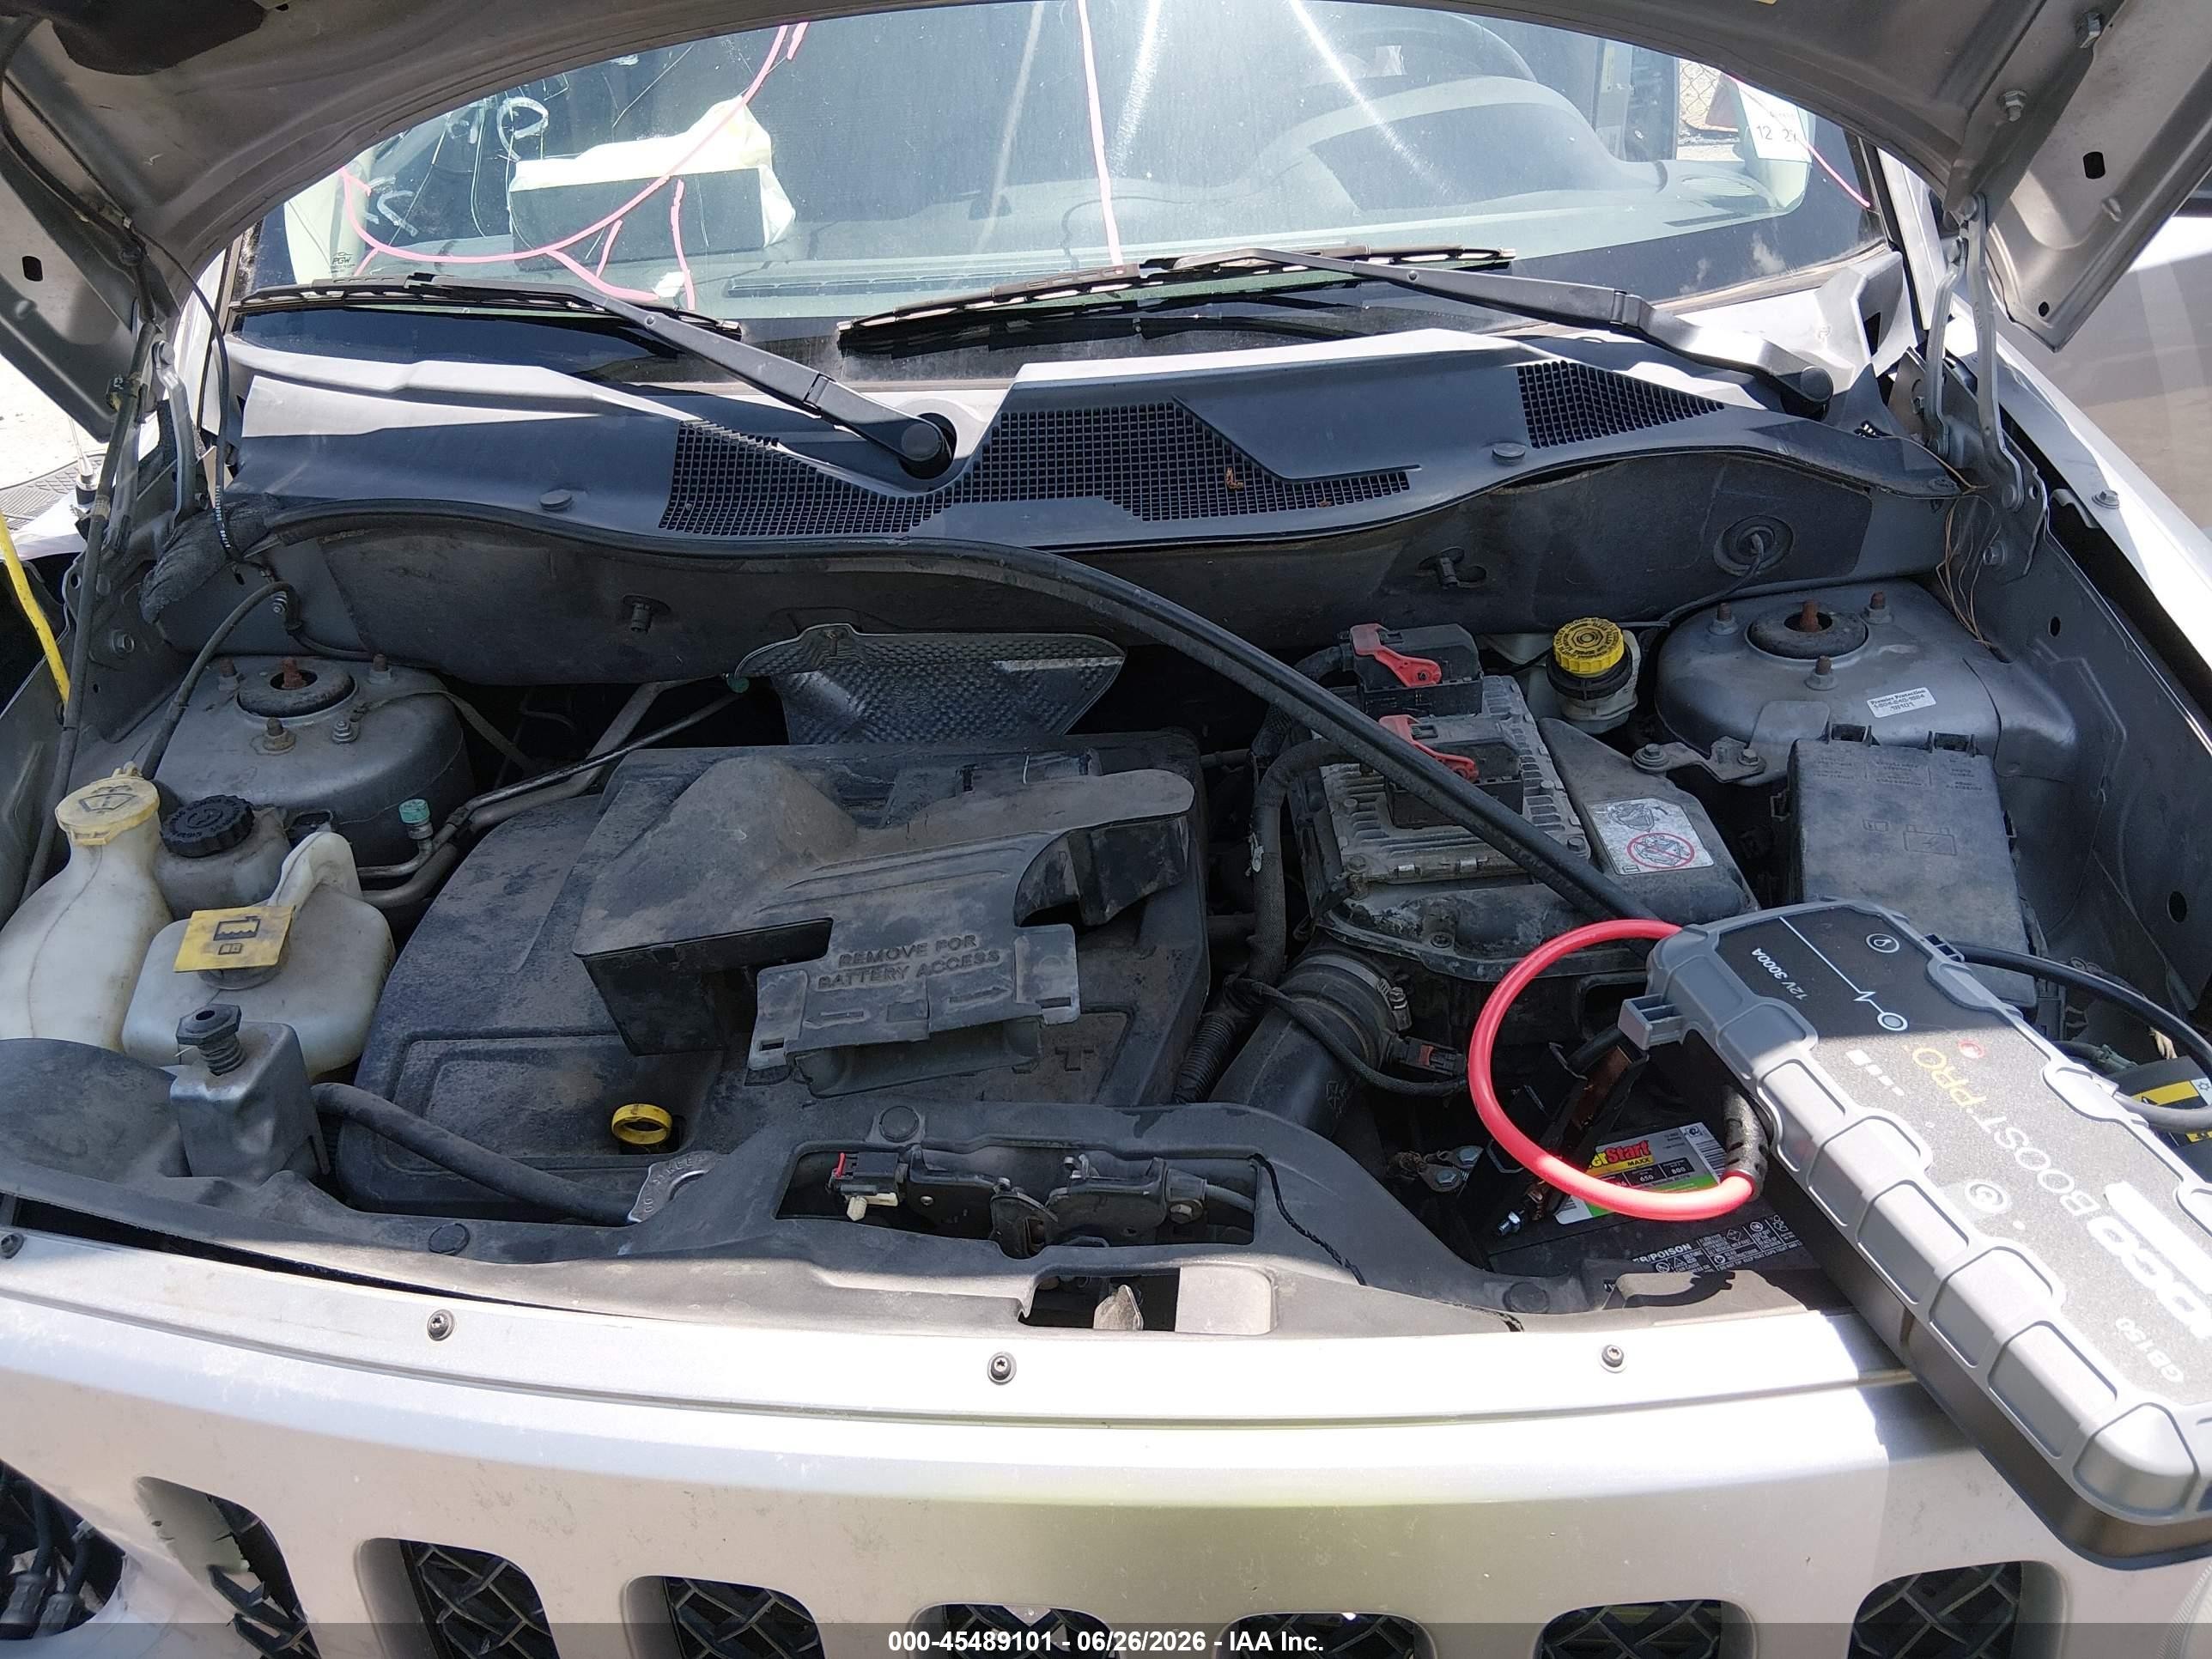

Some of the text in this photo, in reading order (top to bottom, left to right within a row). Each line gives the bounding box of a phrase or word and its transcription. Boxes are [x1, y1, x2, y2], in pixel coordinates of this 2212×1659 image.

[817, 948, 1001, 988] BATTERY ACCESS
[837, 933, 977, 969] REMOVE FOR
[1751, 947, 1808, 1000] 12V 3000A
[1911, 1047, 1988, 1107] PRO
[1626, 1157, 1650, 1167] MAXX
[1971, 1115, 2101, 1217] BOOST
